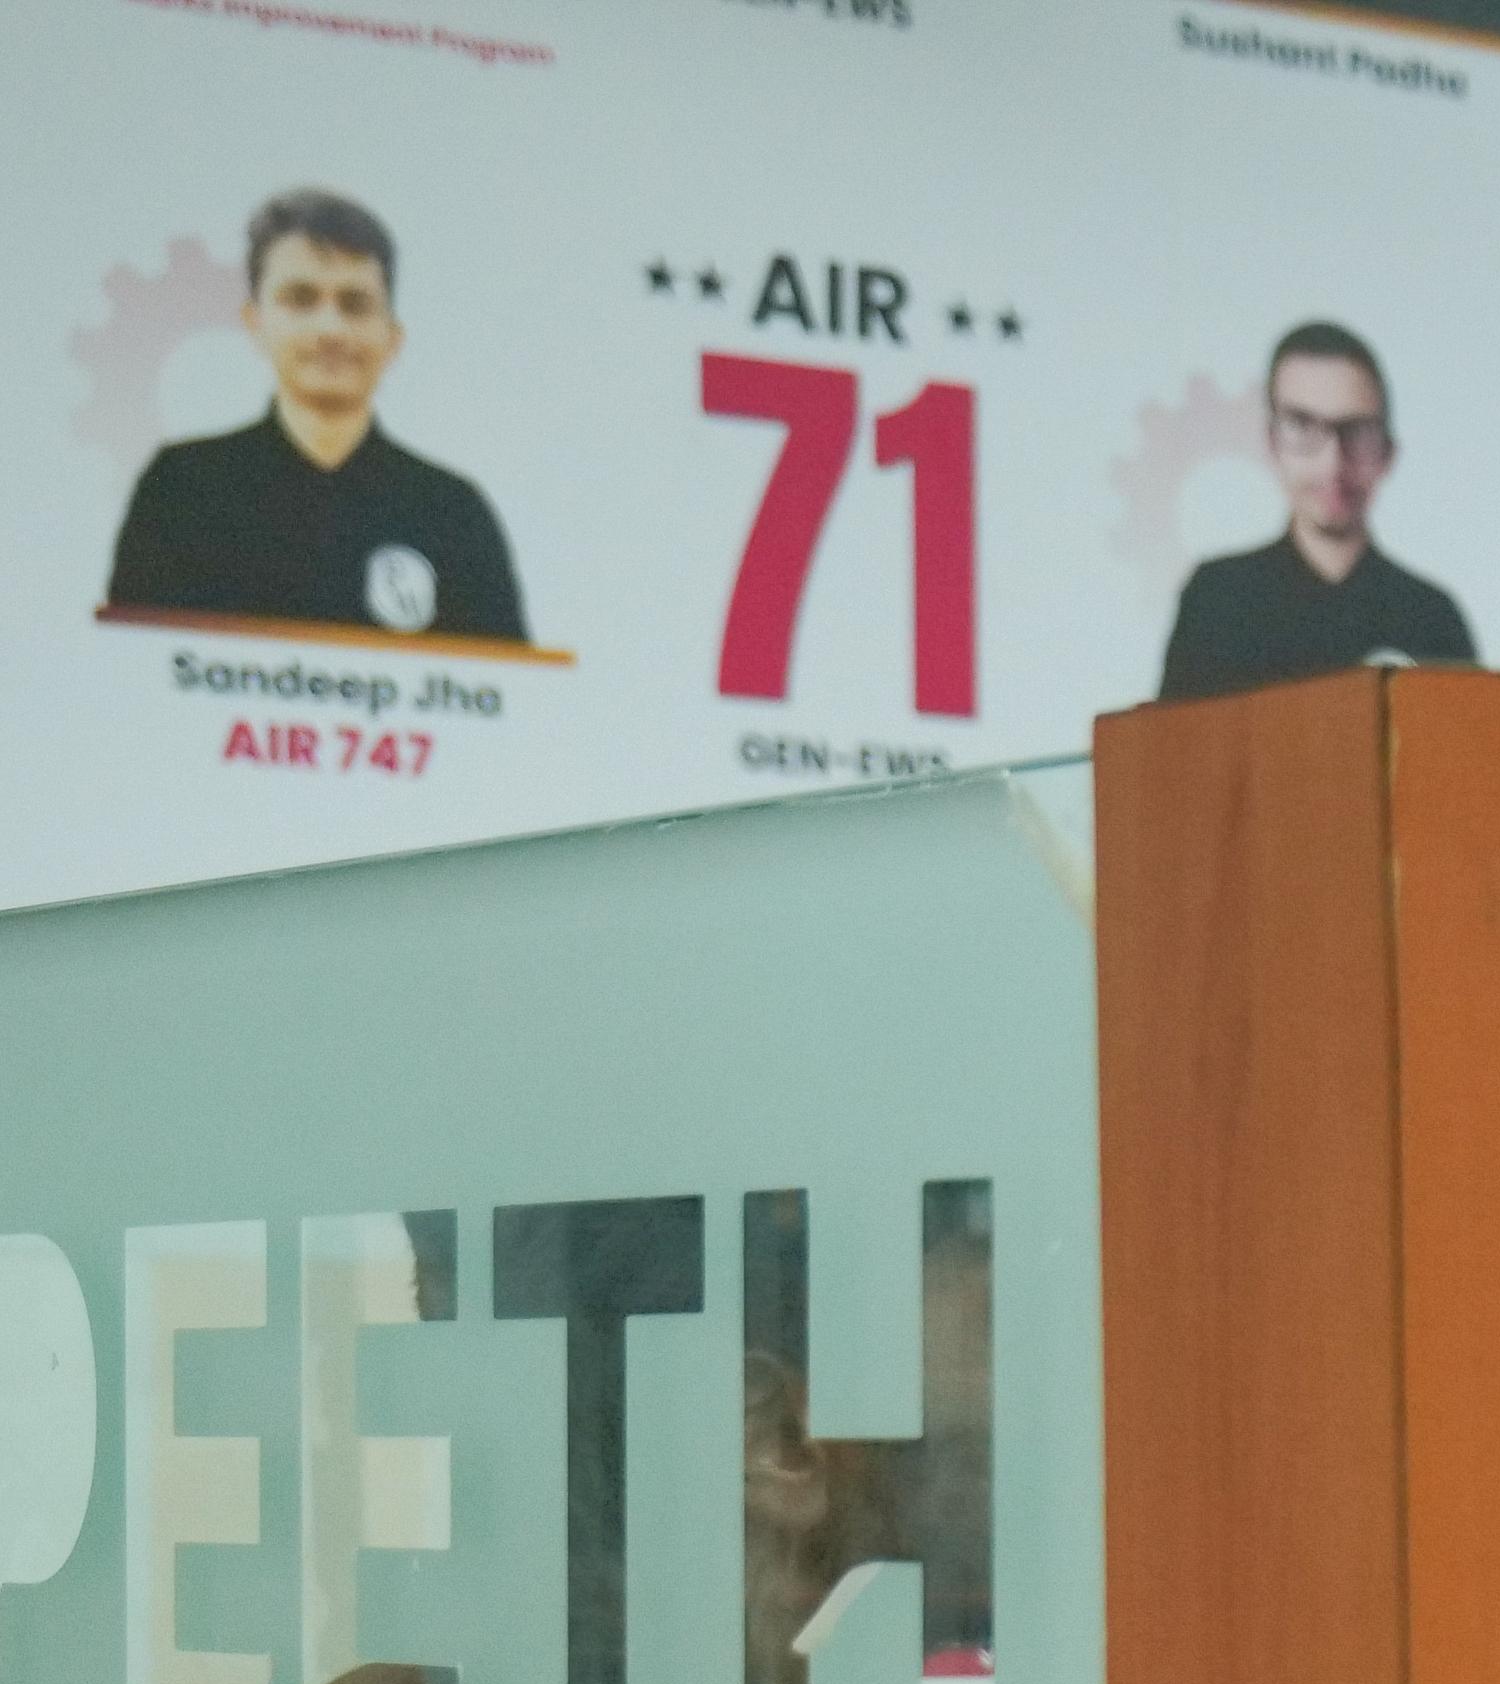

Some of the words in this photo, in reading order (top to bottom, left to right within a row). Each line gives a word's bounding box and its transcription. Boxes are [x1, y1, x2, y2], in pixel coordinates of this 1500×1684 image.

[431, 25, 554, 66] Program
[751, 254, 911, 344] AIR
[698, 351, 978, 717] 71
[174, 653, 398, 719] Sandeep
[413, 672, 503, 718] Jha
[223, 717, 320, 769] AIR
[336, 723, 432, 777] 747
[739, 733, 949, 775] GEN-EWS
